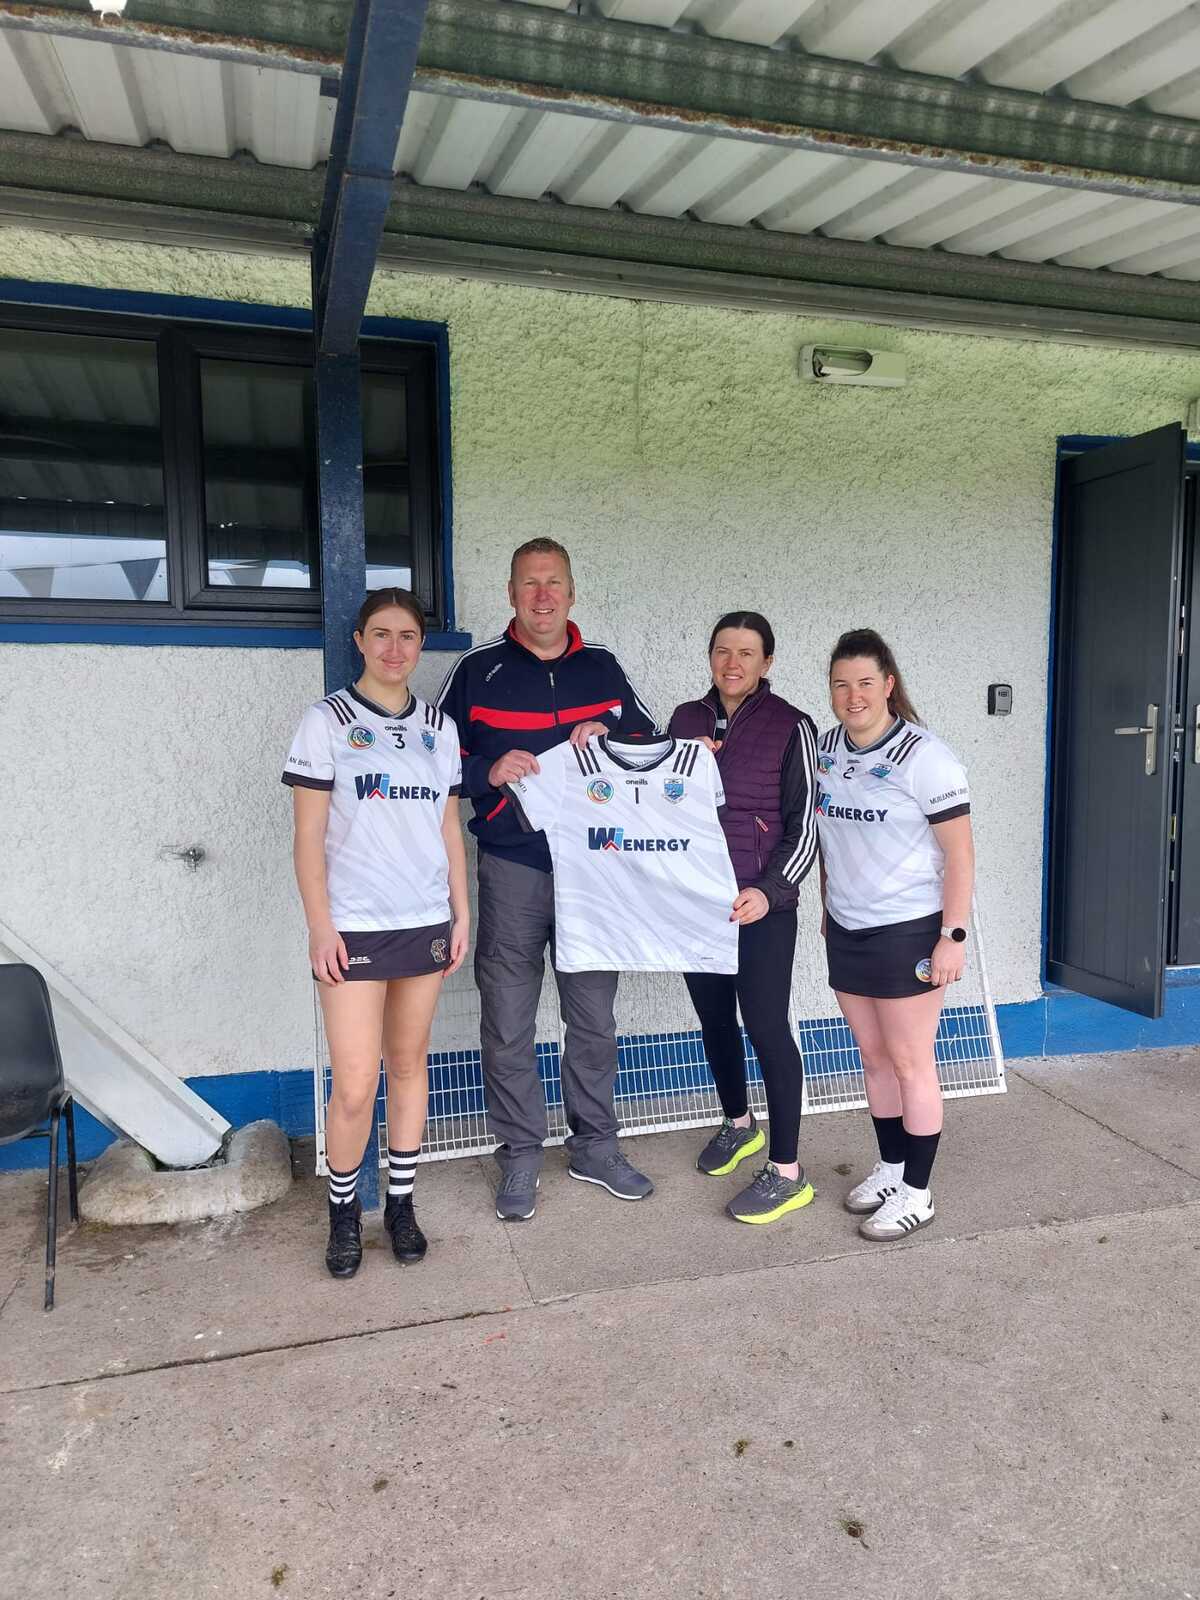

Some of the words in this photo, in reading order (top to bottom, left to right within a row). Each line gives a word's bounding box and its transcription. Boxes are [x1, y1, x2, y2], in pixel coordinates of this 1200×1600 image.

[391, 733, 406, 749] 3
[843, 766, 855, 780] 2
[634, 787, 640, 804] 1
[827, 805, 889, 822] ENERGY
[623, 838, 691, 852] ENERGY
